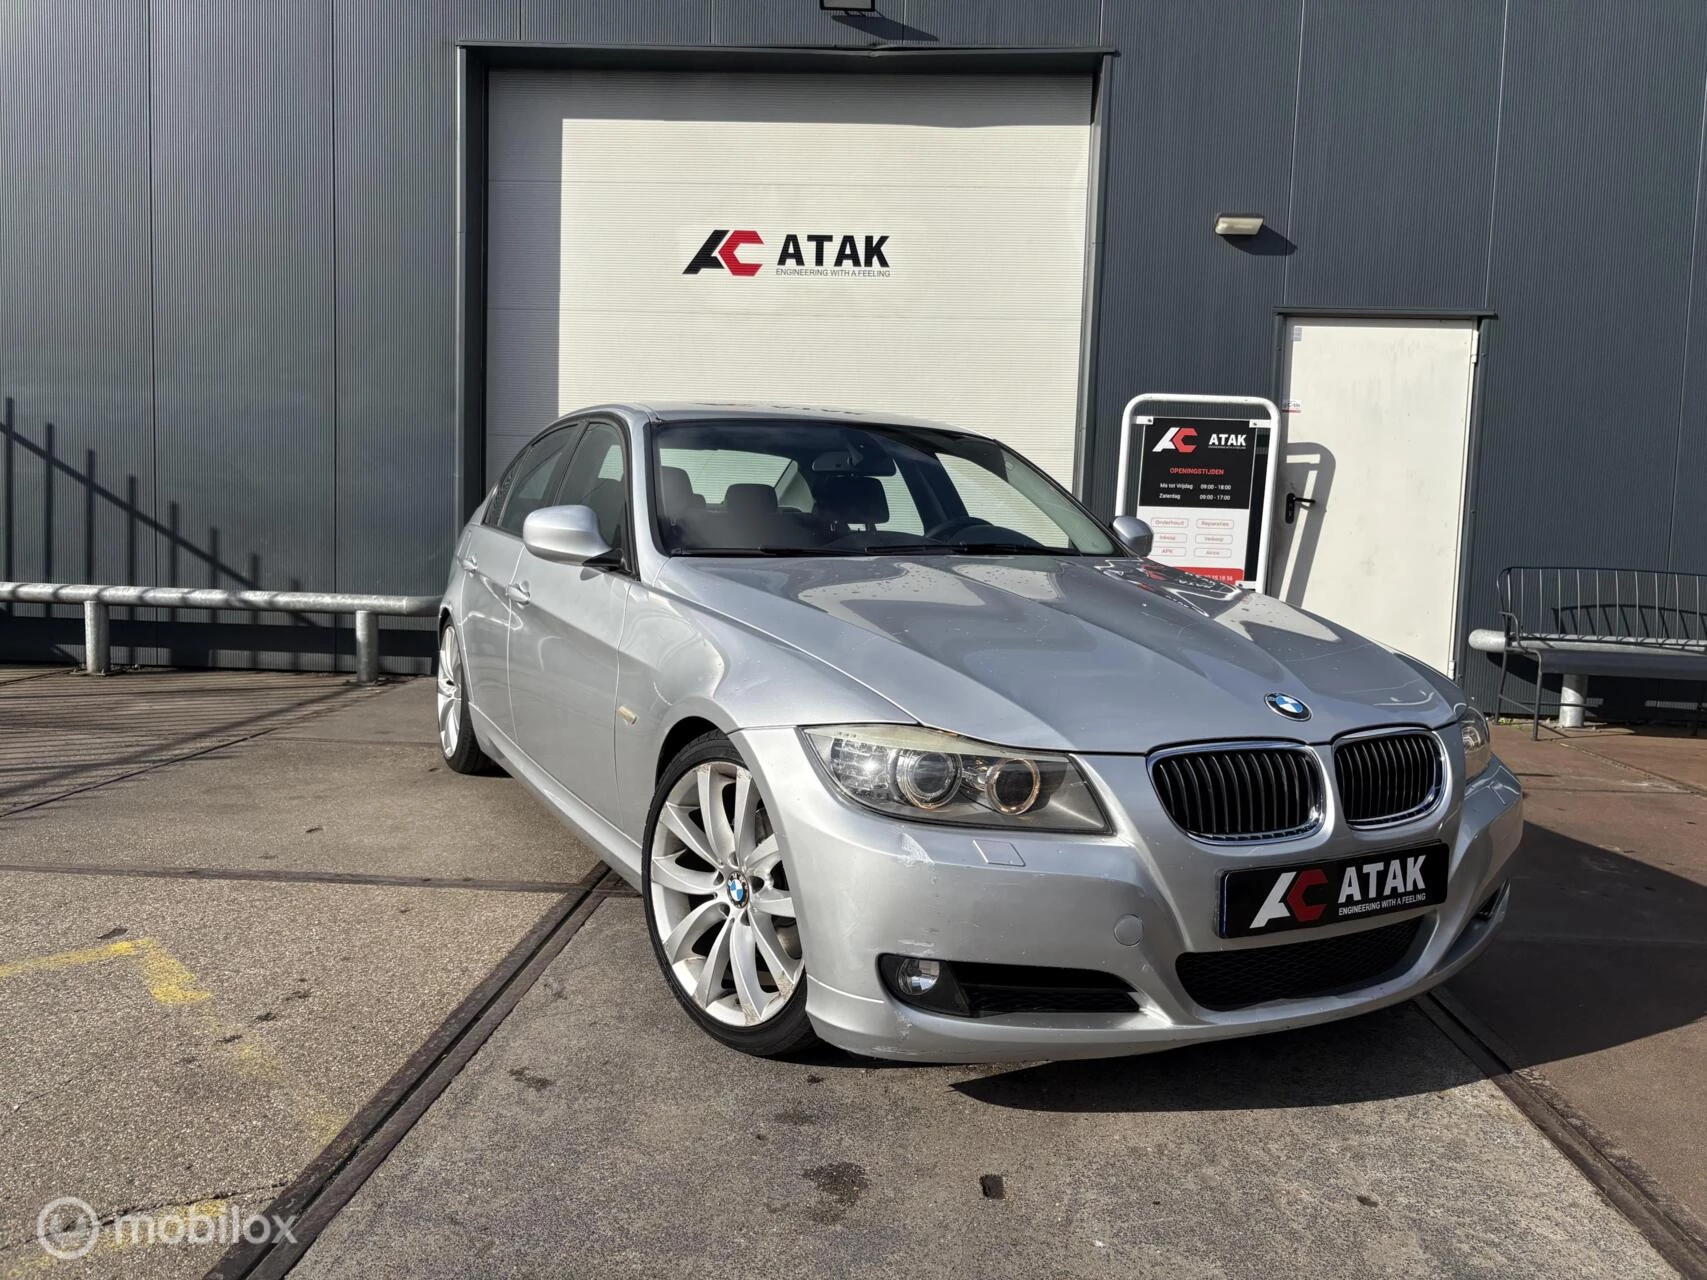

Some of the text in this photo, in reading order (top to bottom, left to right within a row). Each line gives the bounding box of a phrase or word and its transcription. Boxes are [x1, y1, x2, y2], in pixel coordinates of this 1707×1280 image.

[777, 234, 890, 268] ATAK
[776, 268, 829, 277] ENGINEERING
[830, 269, 850, 277] WITH
[858, 270, 891, 278] FEELING
[1208, 433, 1247, 446] ATAK
[1169, 467, 1225, 475] OPENINGSTIJDEN
[1338, 855, 1426, 904] ATAK
[1338, 902, 1381, 916] ENGINEERING
[1381, 899, 1397, 910] WITH
[1401, 893, 1427, 905] FEELING
